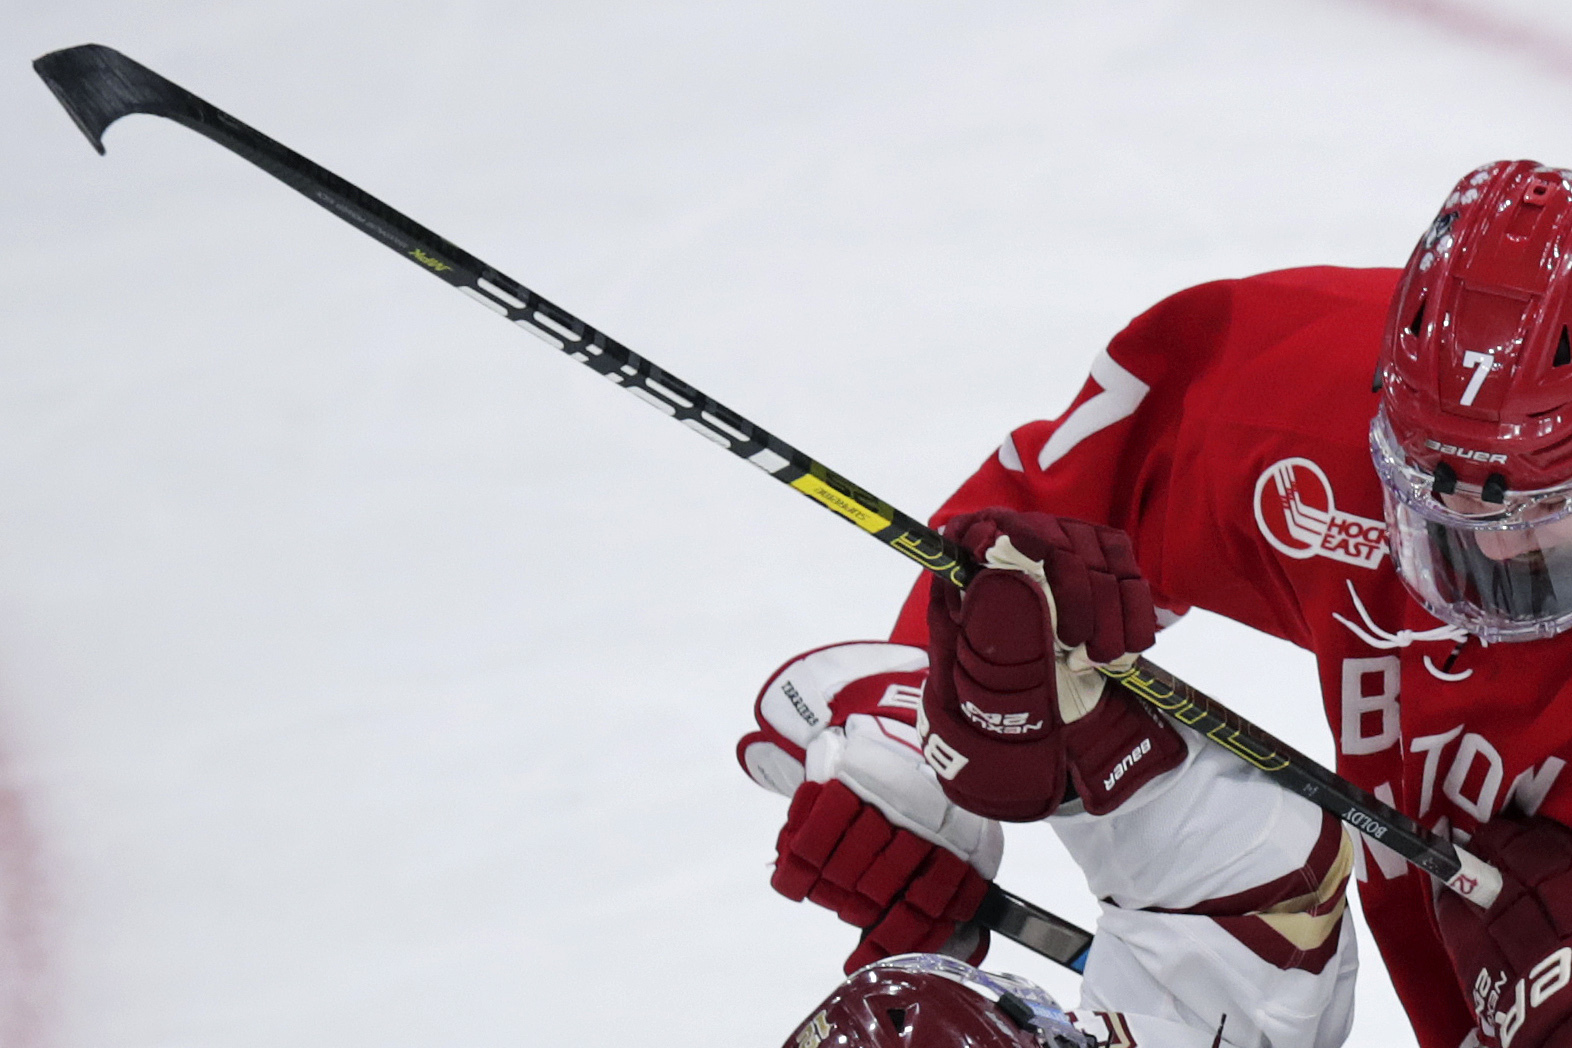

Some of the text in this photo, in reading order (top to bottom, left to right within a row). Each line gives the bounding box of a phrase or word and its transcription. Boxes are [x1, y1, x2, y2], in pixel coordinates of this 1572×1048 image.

[1461, 350, 1495, 407] 7
[1321, 533, 1380, 560] EAST
[780, 680, 820, 729] TERRIERS
[1340, 655, 1567, 824] BTON
[1342, 806, 1388, 840] BOLDY
[1450, 873, 1479, 896] 12
